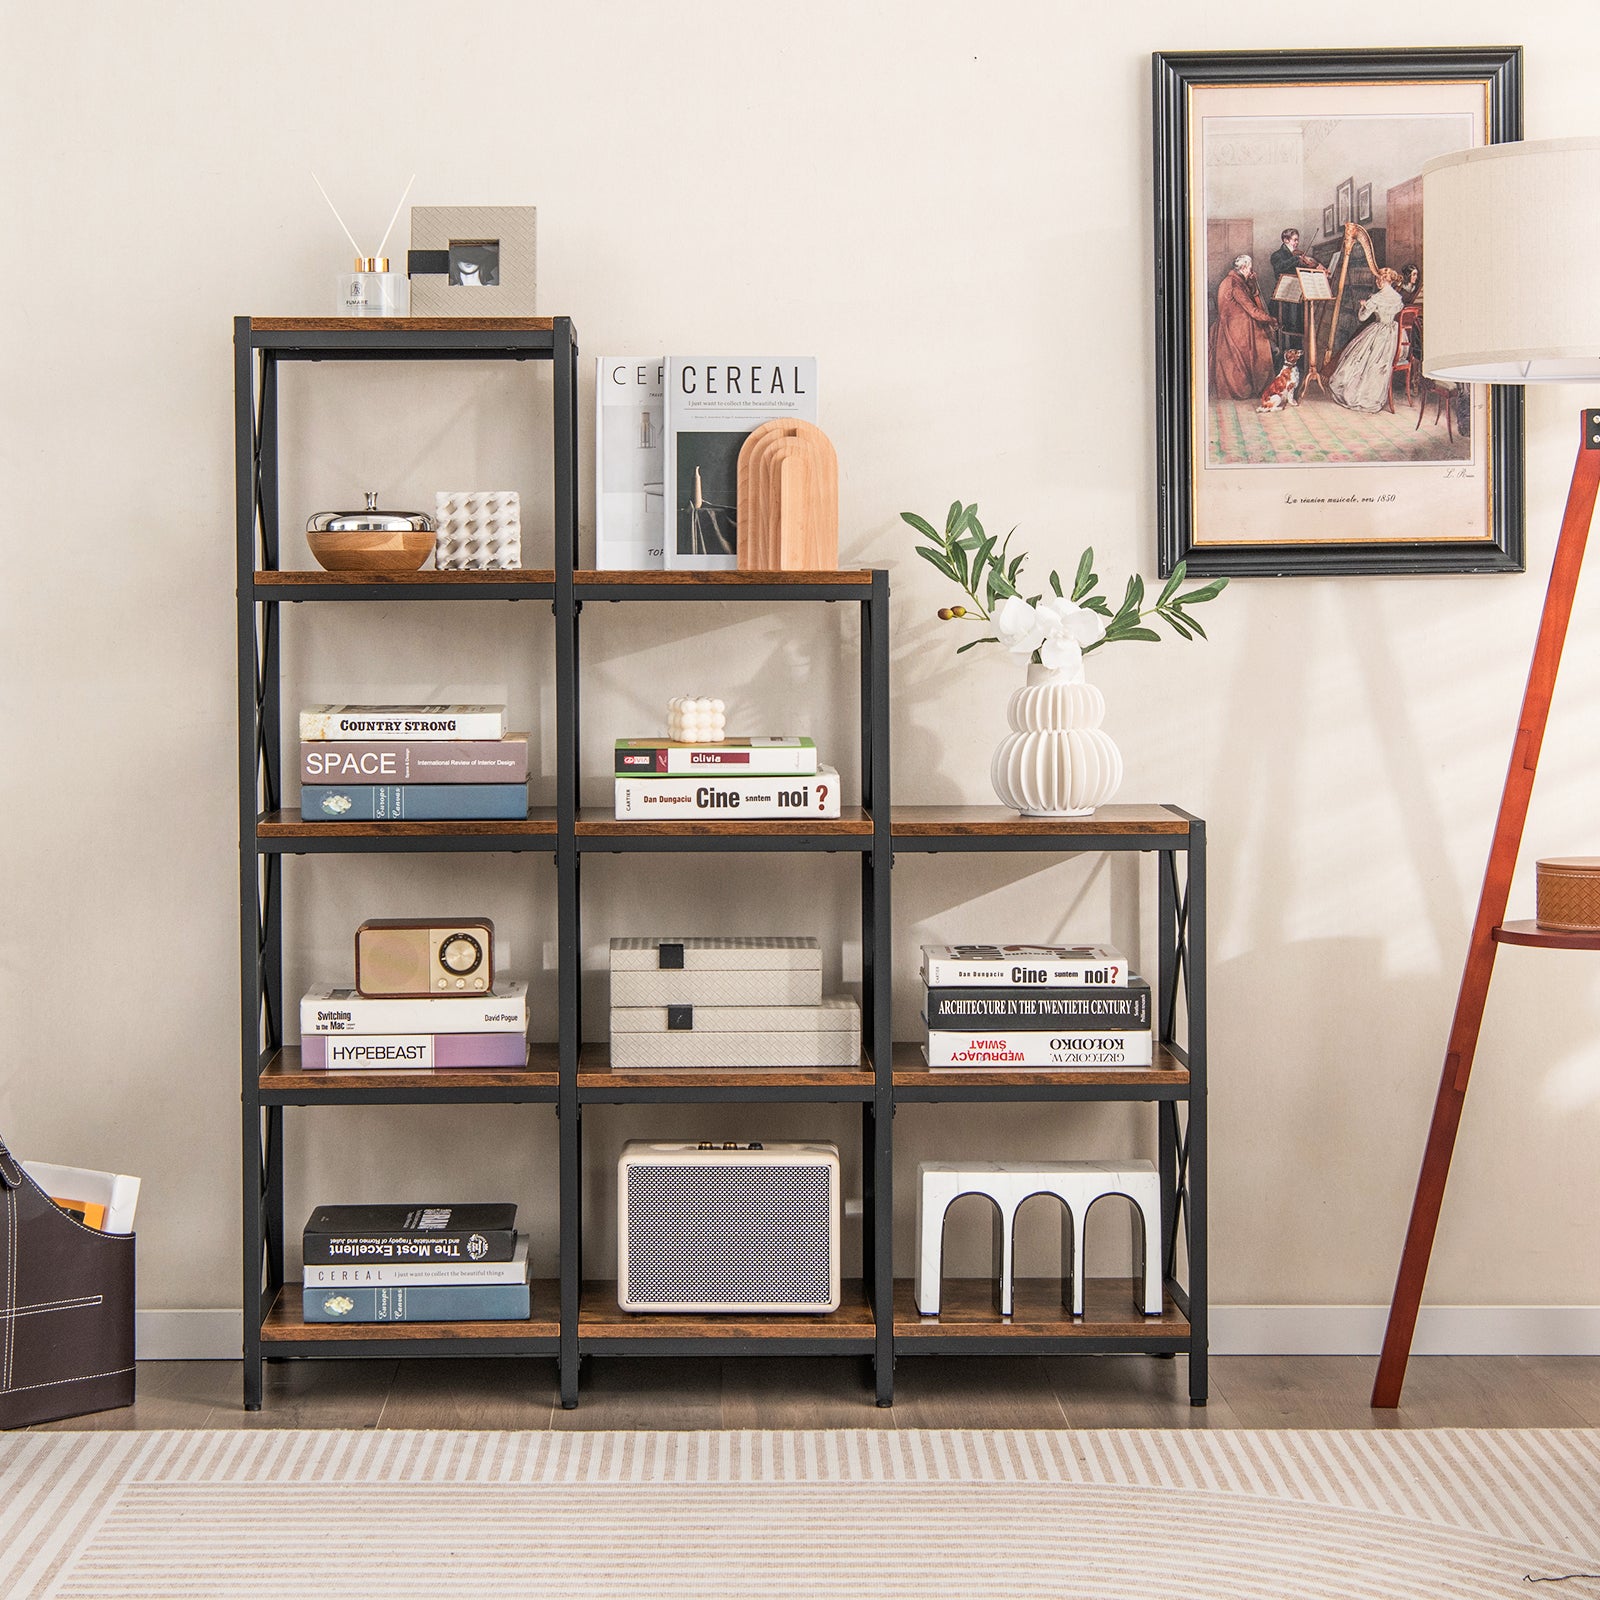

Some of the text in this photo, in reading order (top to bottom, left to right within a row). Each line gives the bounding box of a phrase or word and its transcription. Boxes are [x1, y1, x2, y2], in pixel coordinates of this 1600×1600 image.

[681, 366, 806, 394] CEREAL
[1377, 494, 1396, 503] 1850
[340, 719, 457, 731] COUNTRY STRONG
[305, 752, 397, 775] SPACE
[496, 760, 516, 768] Design
[692, 753, 721, 763] olivia
[376, 787, 387, 819] Europe
[391, 786, 401, 819] Canvas
[643, 796, 658, 804] Dan
[659, 796, 692, 805] Dungaciu
[696, 787, 740, 809] Cine
[777, 786, 808, 807] noi
[1011, 966, 1047, 984] Cine
[1007, 1000, 1018, 1015] IN
[1019, 1000, 1037, 1015] THE
[1038, 1000, 1089, 1015] TWENTIETH
[1090, 1000, 1133, 1015] CENTURY
[317, 1010, 352, 1021] Switching
[484, 1014, 518, 1023] David Pogue
[330, 1021, 345, 1030] Mac
[969, 1040, 1007, 1051] ŚWIAT
[1049, 1038, 1125, 1050] KOŁODKO
[333, 1046, 427, 1060] HYPEBEAST
[951, 1050, 1025, 1061] WĘDRUJĄCY
[1064, 1053, 1125, 1063] GRZEGORZ
[329, 1244, 393, 1257] Excellent
[396, 1244, 430, 1257] Most
[434, 1244, 460, 1257] The
[318, 1271, 383, 1281] CEREAL
[486, 1270, 505, 1278] things
[378, 1288, 389, 1320] Europe
[394, 1288, 403, 1320] Canvas
